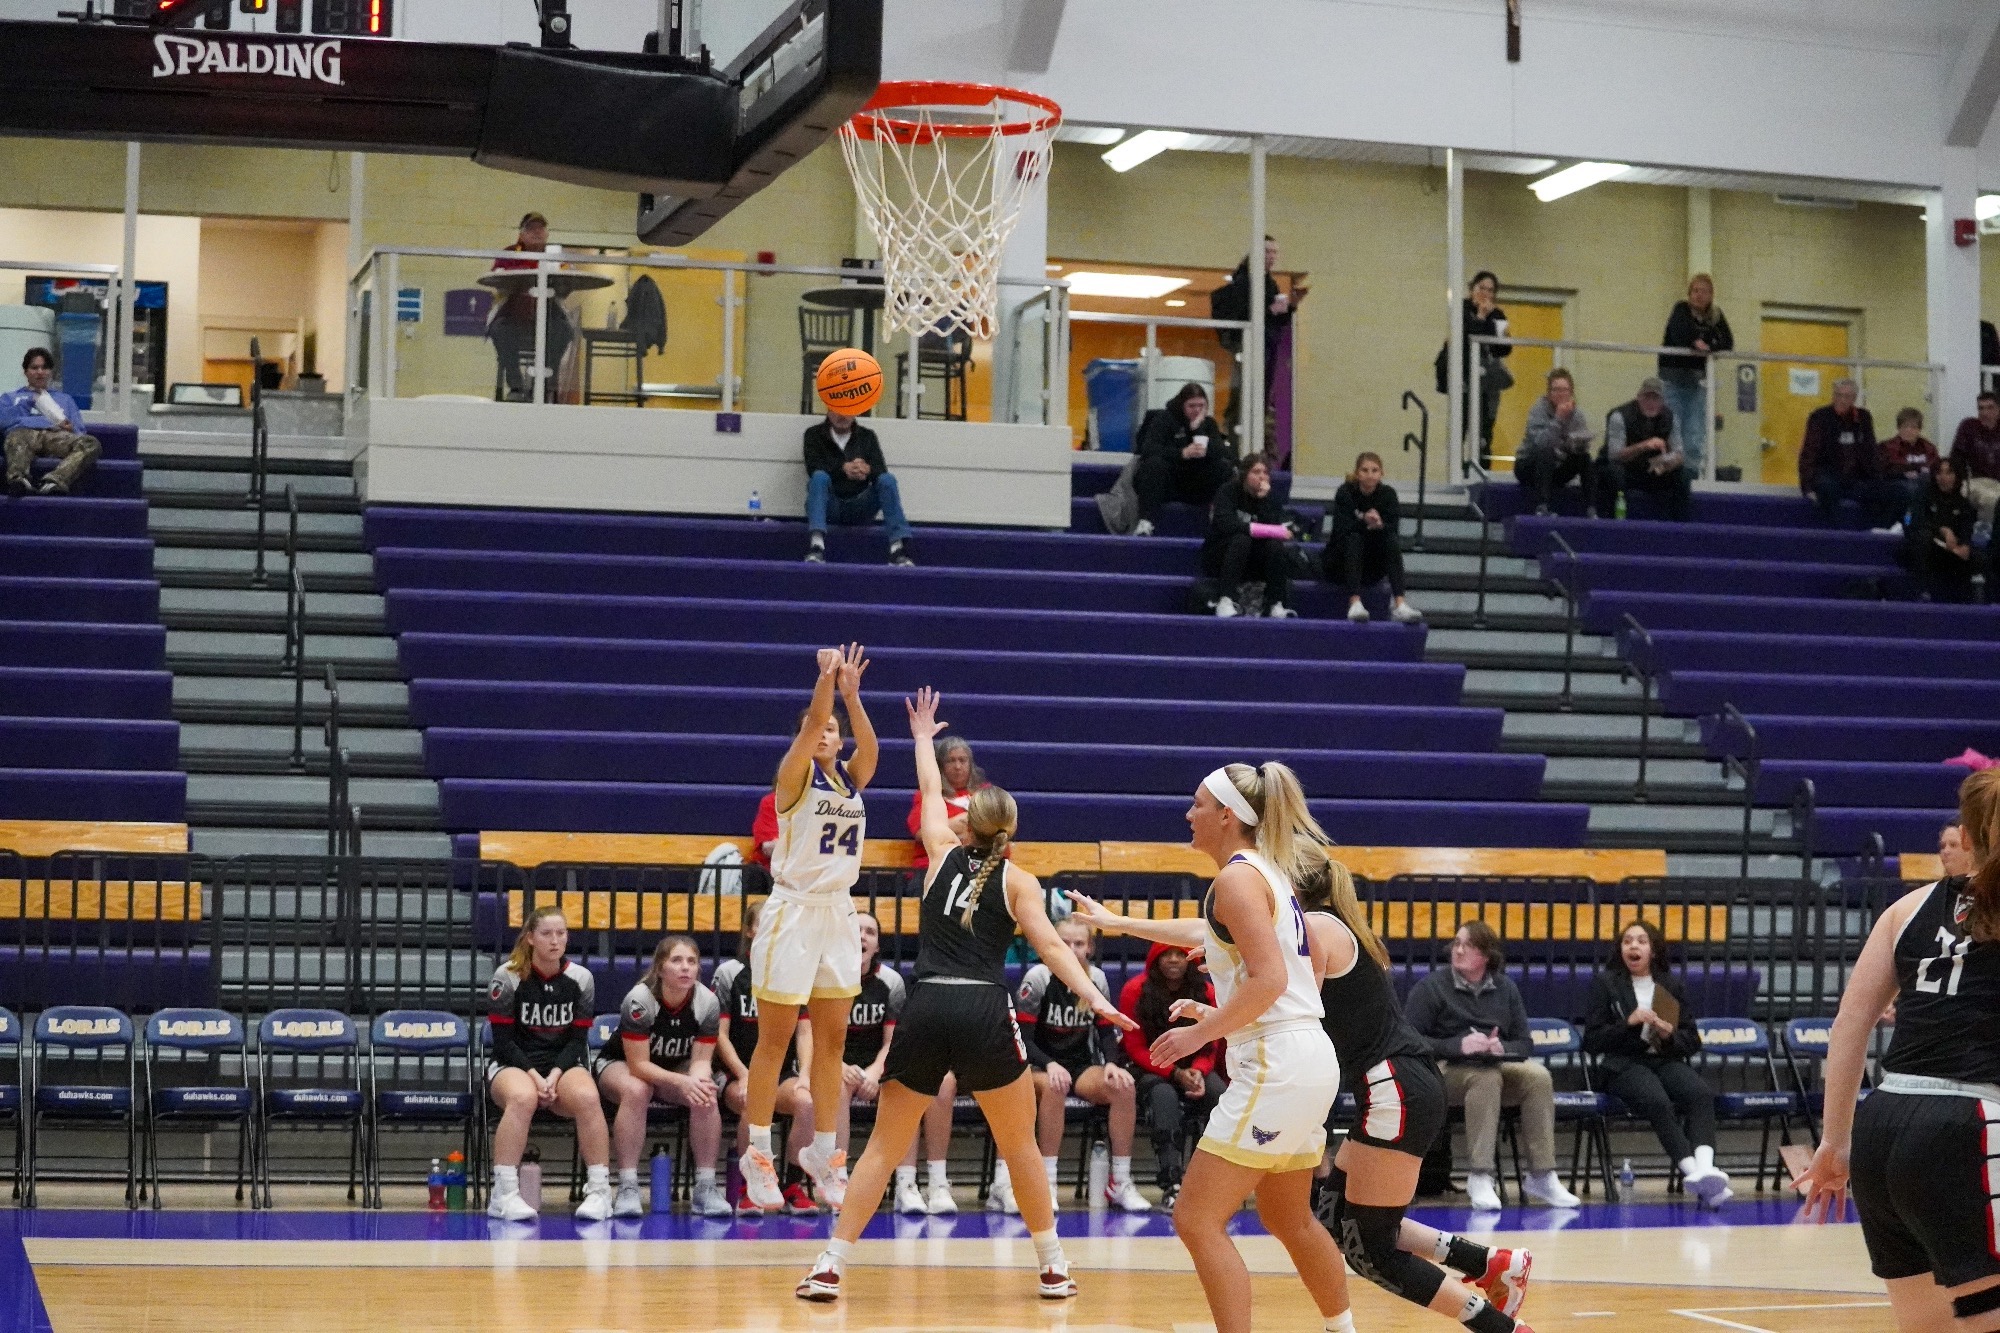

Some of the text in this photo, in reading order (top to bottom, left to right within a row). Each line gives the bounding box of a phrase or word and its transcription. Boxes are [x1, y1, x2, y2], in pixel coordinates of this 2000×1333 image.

[153, 34, 345, 86] SPALDING
[828, 382, 872, 400] Wilson
[819, 822, 859, 856] 24
[943, 872, 979, 916] 14
[1915, 925, 1973, 996] 21
[521, 1001, 574, 1027] EAGLES
[847, 1003, 886, 1026] GLES
[48, 1018, 121, 1034] LORAS
[158, 1020, 231, 1036] LORAS
[272, 1021, 345, 1037] LORAS
[384, 1022, 457, 1038] LORAS
[1530, 1028, 1571, 1045] RAS
[59, 1091, 113, 1101] duhawks.com
[183, 1092, 237, 1102] duhawks.com
[294, 1093, 348, 1103] duhawks.com
[404, 1095, 458, 1105] duhawks.com
